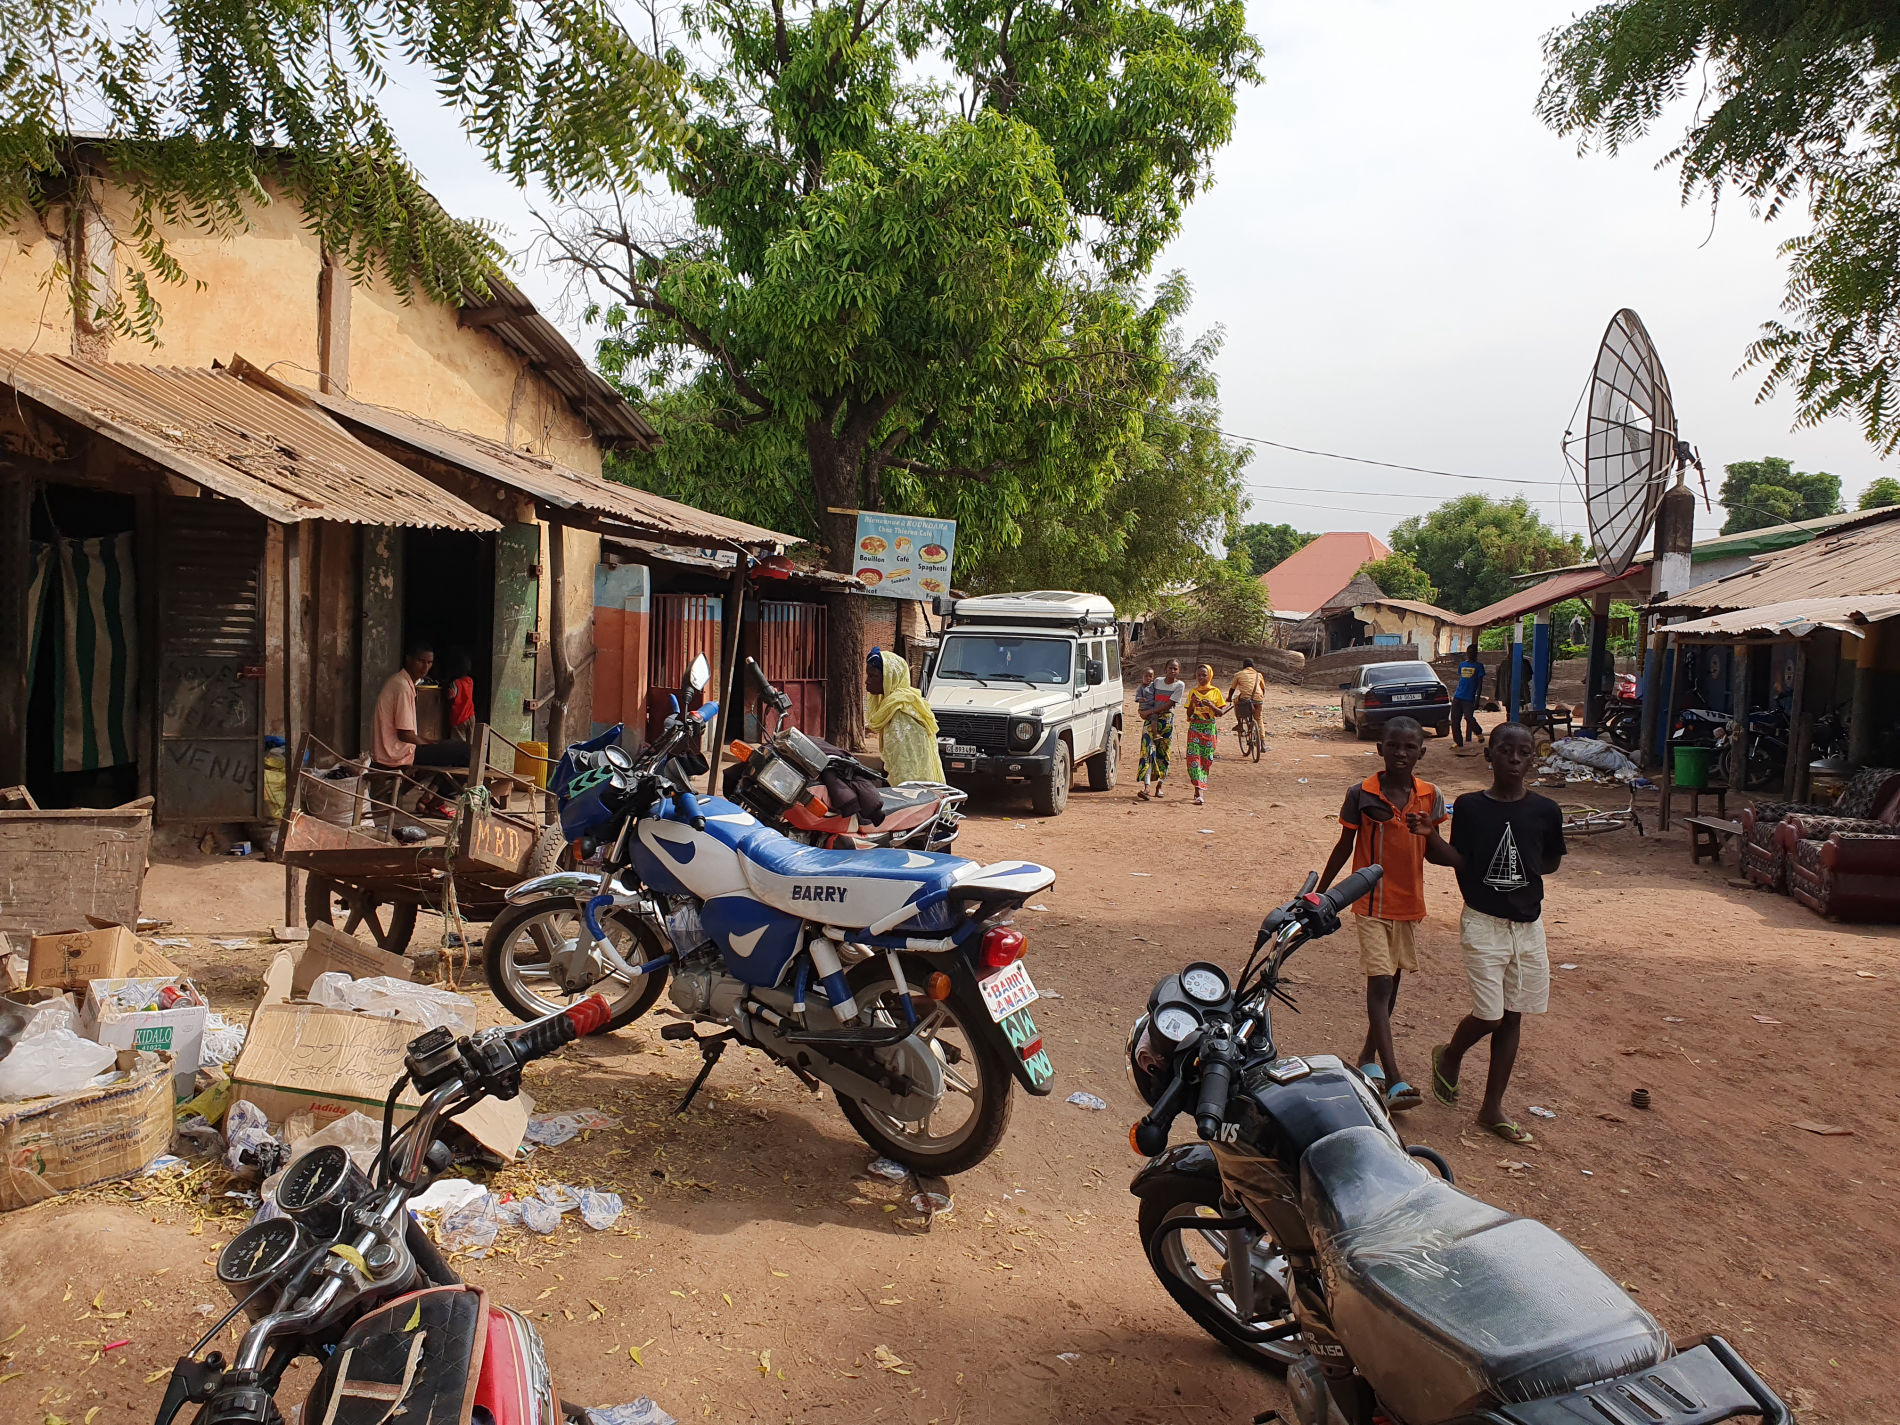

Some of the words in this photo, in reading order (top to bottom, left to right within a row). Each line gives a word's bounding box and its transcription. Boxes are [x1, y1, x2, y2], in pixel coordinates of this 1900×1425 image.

[860, 554, 885, 563] Bouillon
[918, 563, 948, 572] Spaghetti
[890, 576, 910, 584] Sandwich
[169, 744, 257, 793] VENUS
[475, 820, 520, 862] MBD
[792, 885, 848, 902] BARRY
[990, 971, 1026, 999] BARRY
[136, 1028, 172, 1044] KIDALO
[309, 1102, 348, 1115] Jadida
